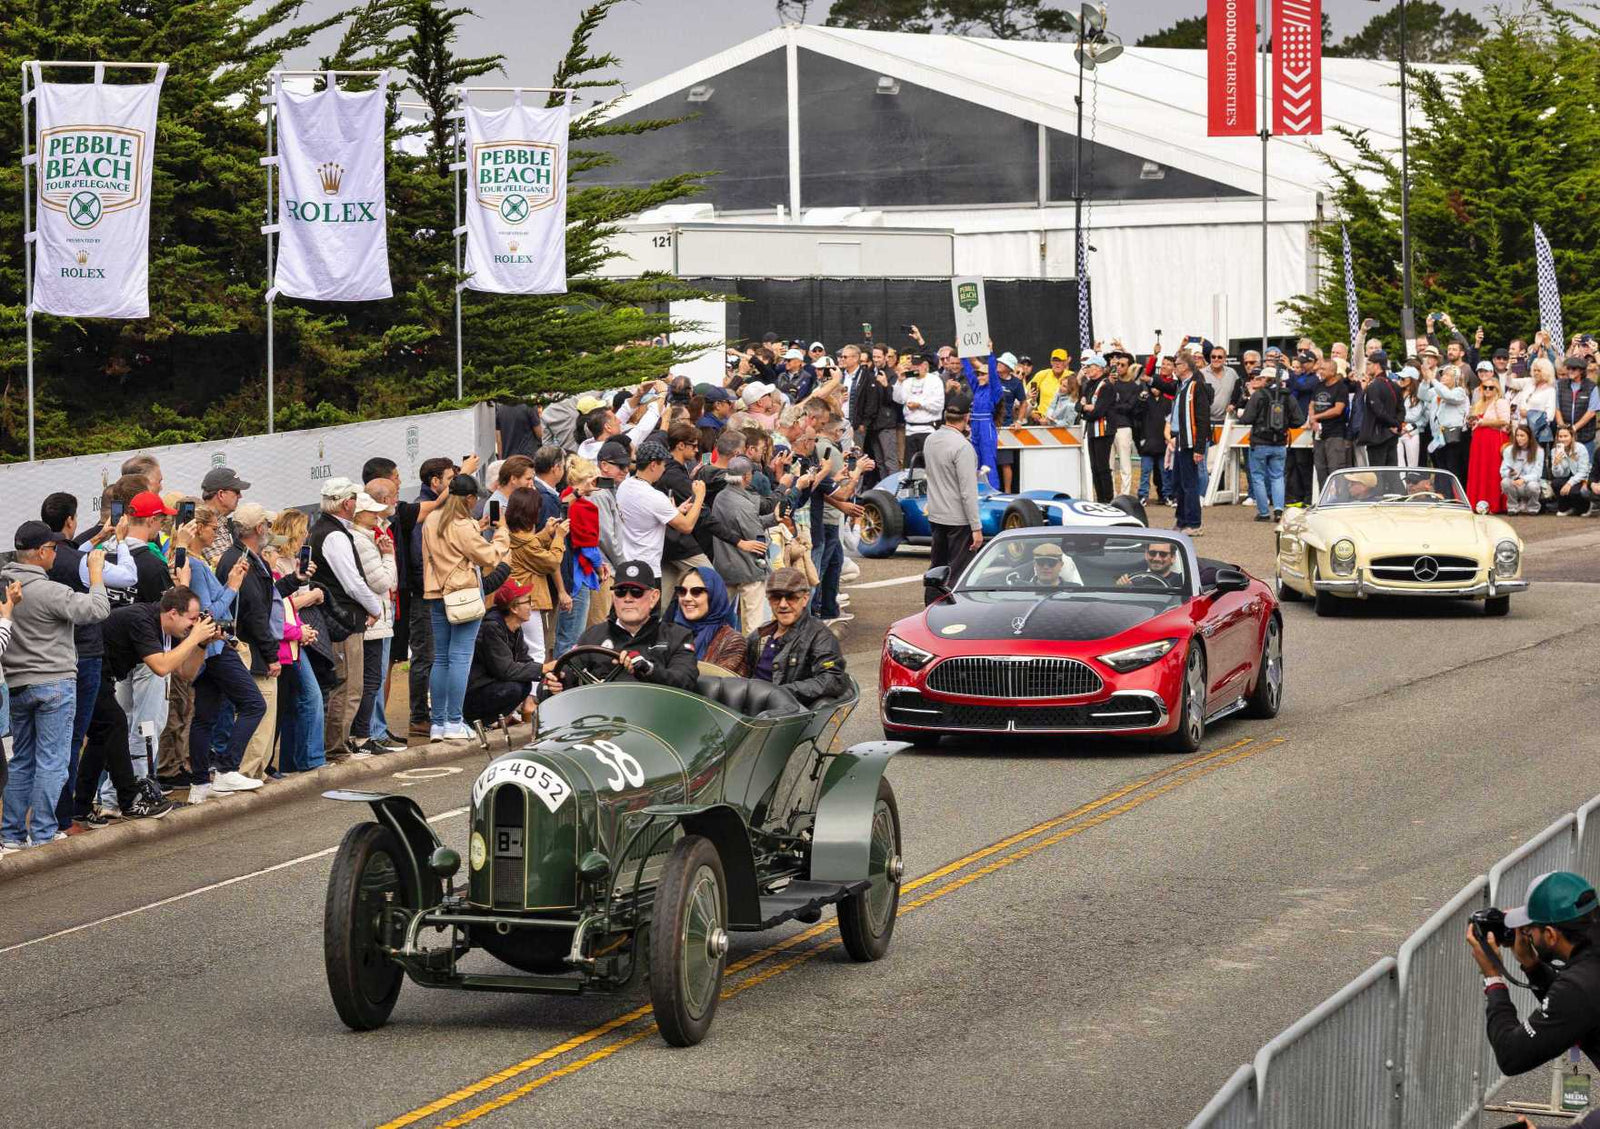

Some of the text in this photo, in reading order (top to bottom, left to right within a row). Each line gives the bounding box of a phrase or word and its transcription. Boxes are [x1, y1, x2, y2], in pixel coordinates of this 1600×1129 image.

[1226, 0, 1237, 126] OODINGCHRISTIE'S
[49, 135, 132, 157] PEBBLE
[481, 149, 551, 166] PEBBLE
[46, 157, 131, 180] BEACH
[480, 167, 550, 185] BEACH
[45, 180, 130, 192] TOUR d'ELEGANCE
[480, 185, 500, 193] TOUR
[286, 200, 377, 222] ROLEX
[652, 236, 671, 248] 121
[494, 254, 533, 264] ROLEX
[61, 267, 105, 279] ROLEX
[963, 331, 982, 346] GO!
[310, 464, 333, 480] ROLEX
[572, 739, 645, 792] 38
[1564, 1092, 1588, 1101] MEDIA
